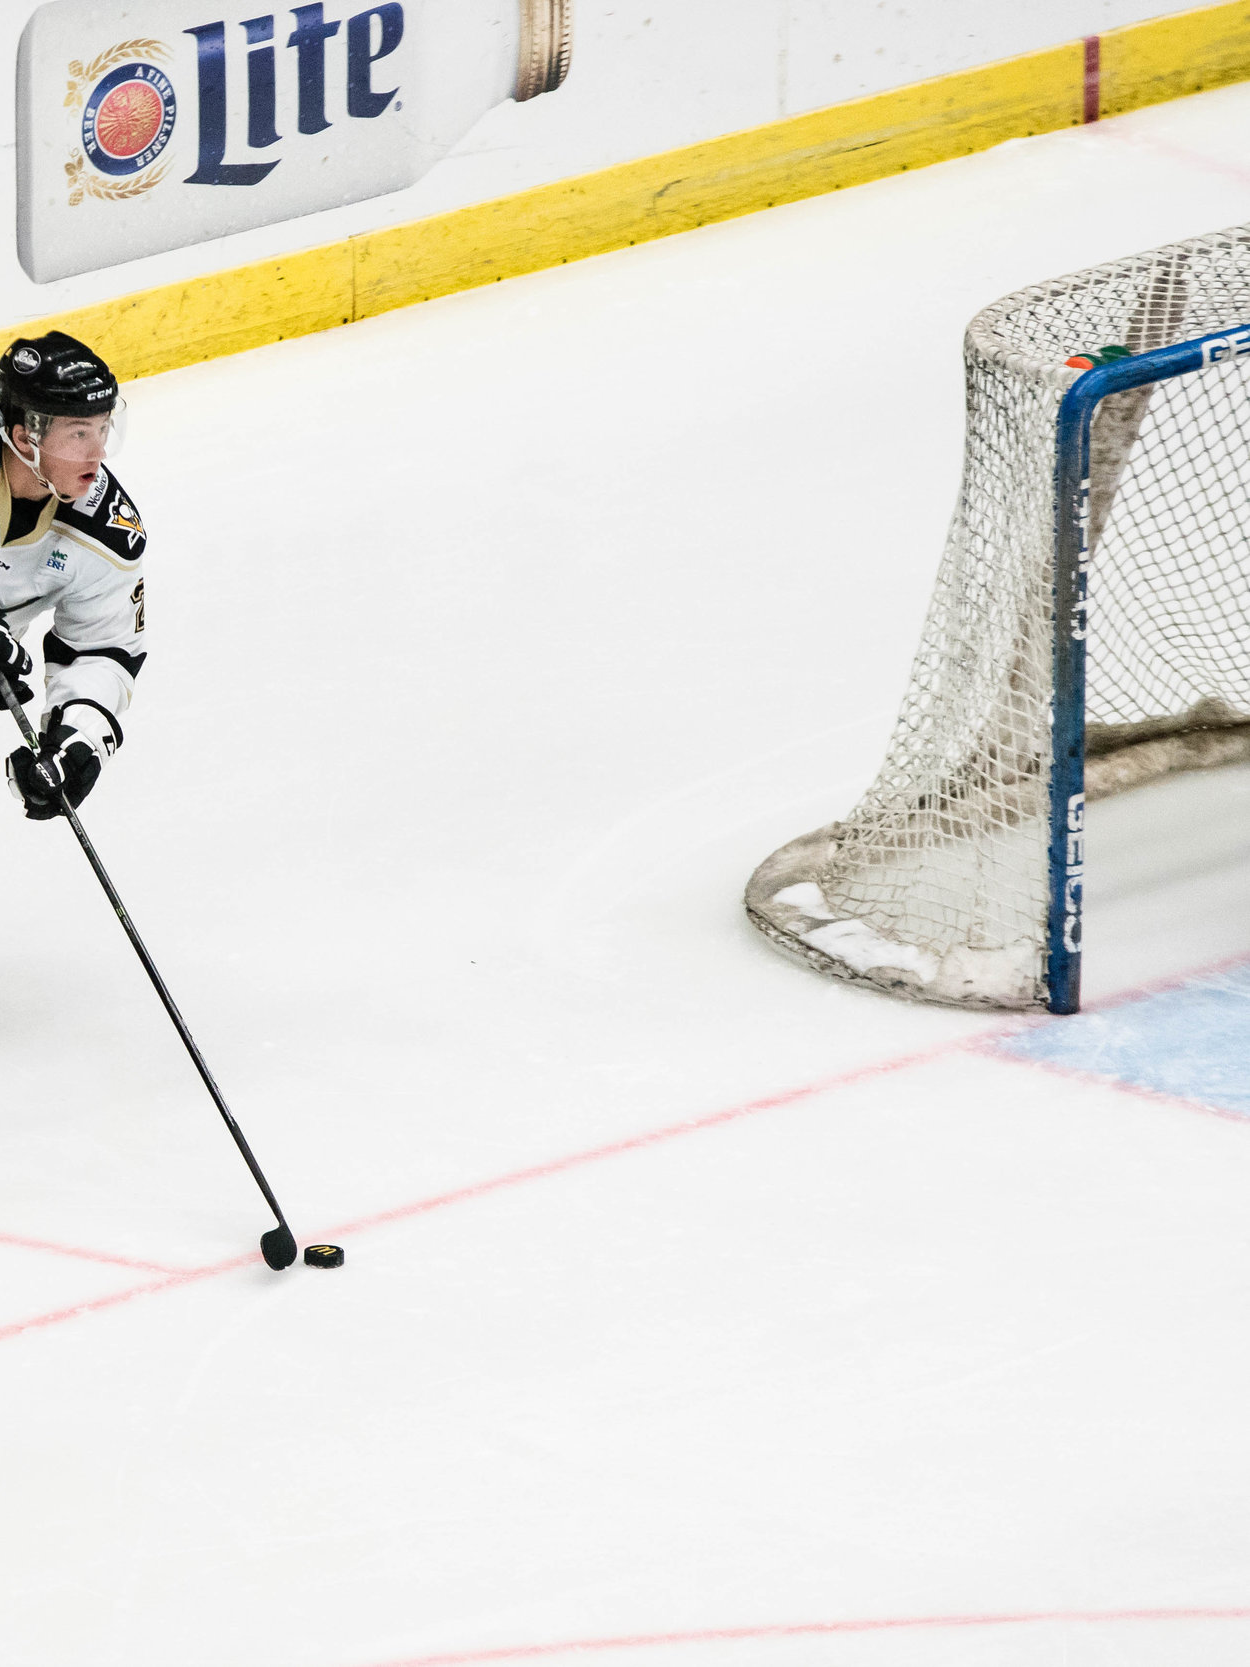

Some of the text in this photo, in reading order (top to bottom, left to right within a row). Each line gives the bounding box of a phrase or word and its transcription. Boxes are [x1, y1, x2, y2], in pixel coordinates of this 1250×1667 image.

[84, 107, 98, 155] BEER
[135, 66, 176, 168] A FINE PILSNER
[182, 2, 405, 186] Lite
[87, 388, 113, 401] CCM
